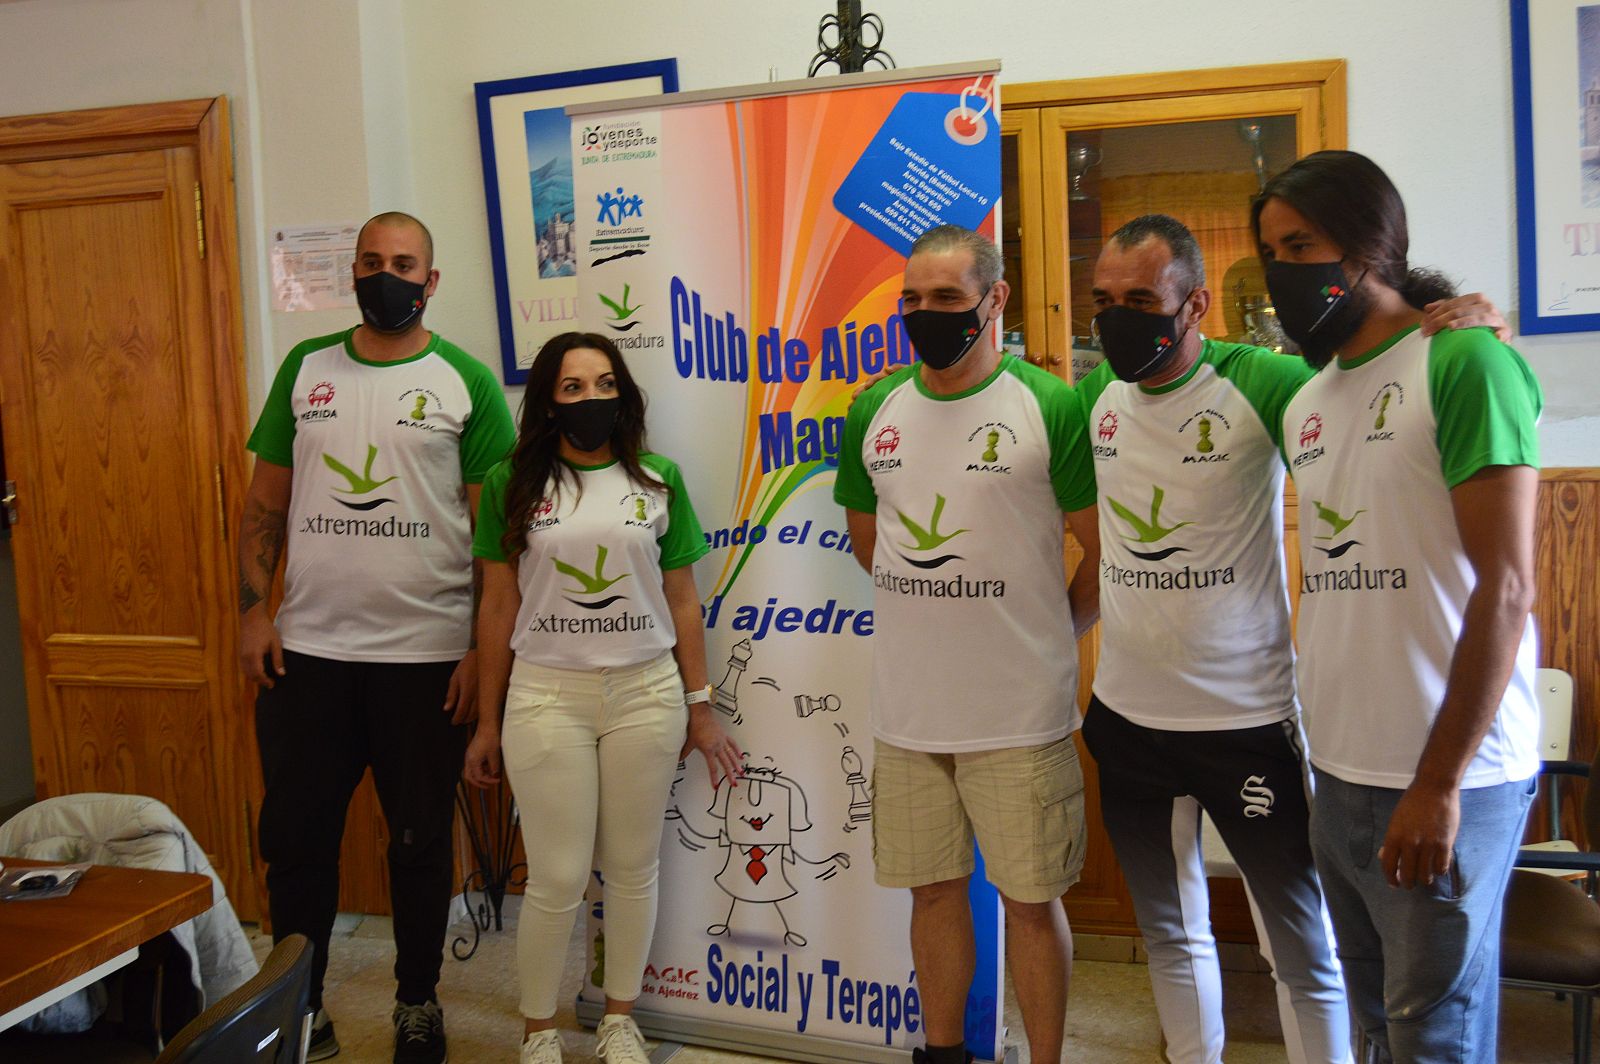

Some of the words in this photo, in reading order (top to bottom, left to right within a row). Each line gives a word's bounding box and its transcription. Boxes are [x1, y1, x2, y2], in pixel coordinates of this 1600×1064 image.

[517, 296, 577, 323] VILL
[670, 275, 748, 384] Club
[757, 326, 810, 384] de
[820, 296, 920, 384] Ajed
[966, 464, 1011, 475] MAGIC
[299, 512, 430, 538] xtremadura
[778, 519, 812, 545] el
[1239, 775, 1275, 818] S
[642, 984, 655, 993] de
[657, 985, 699, 1001] Ajedrez
[706, 942, 788, 1013] Social
[797, 971, 814, 1033] y
[821, 959, 925, 1045] Terapé
